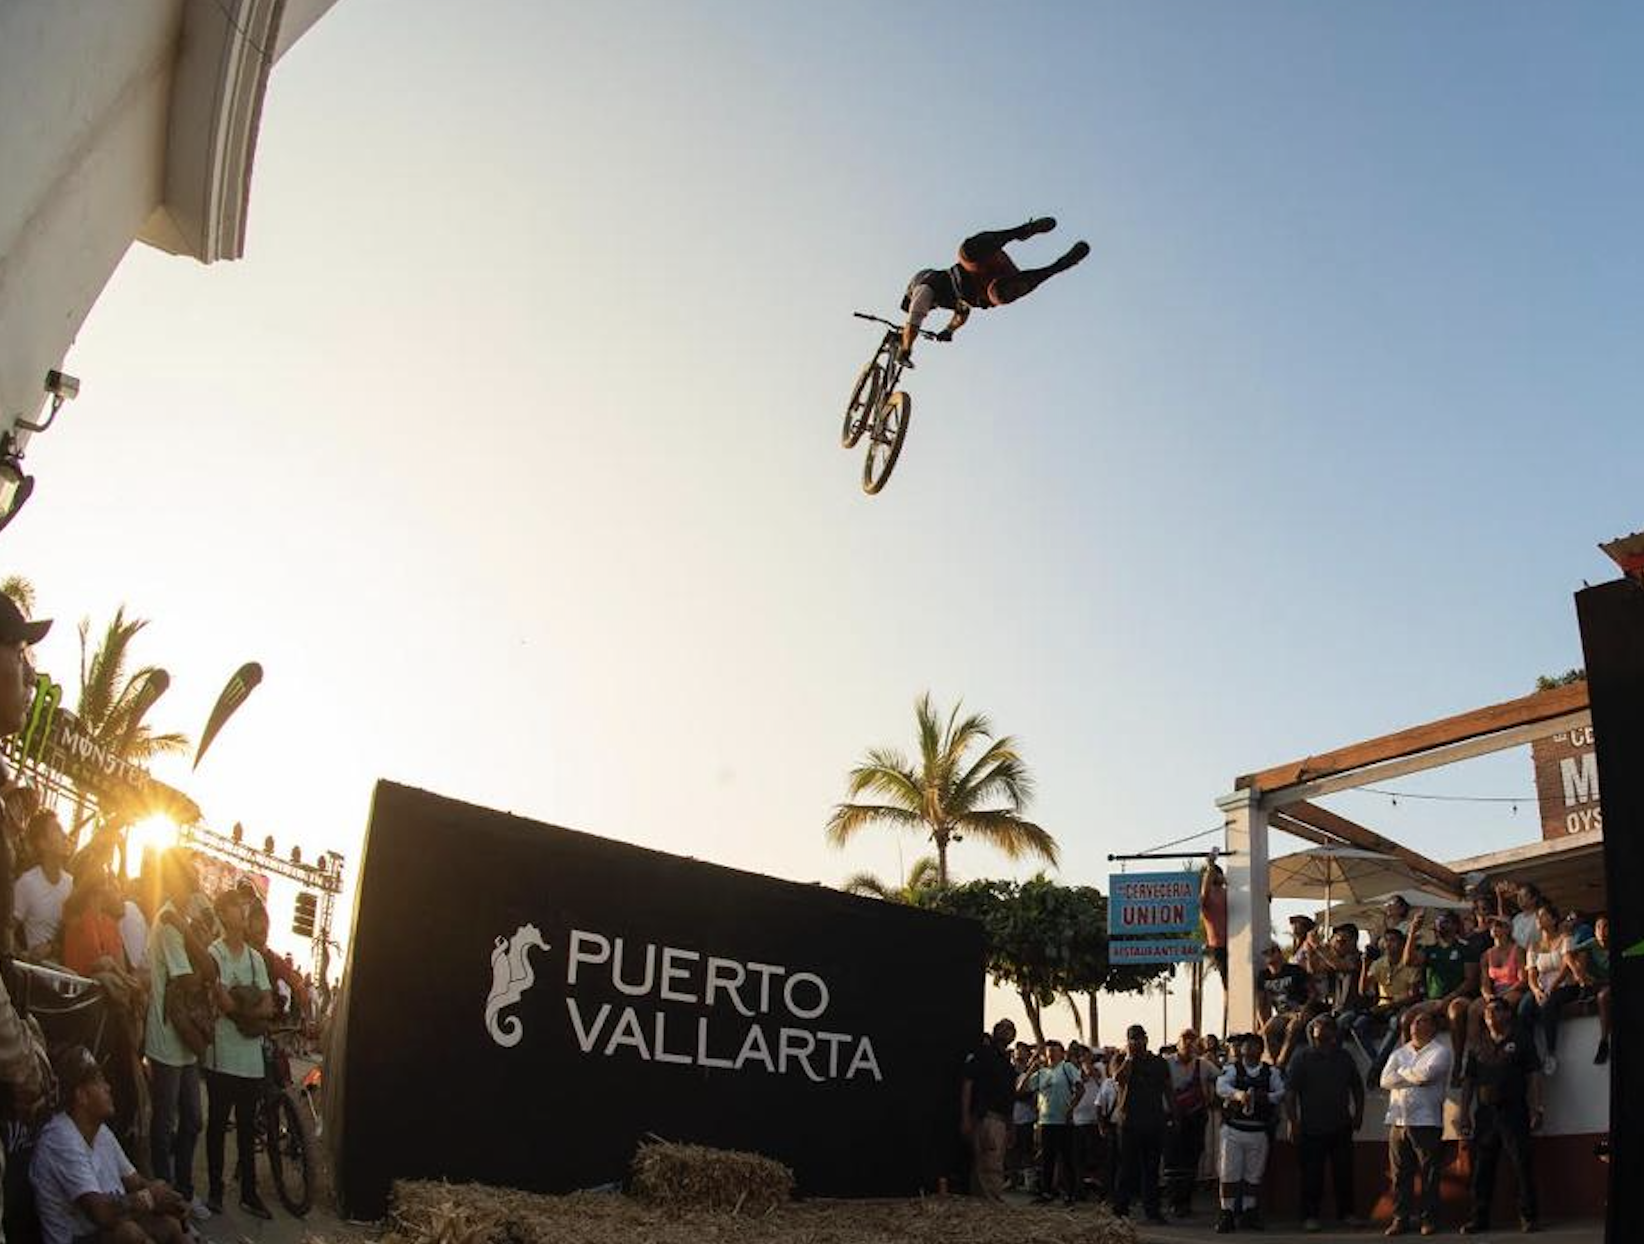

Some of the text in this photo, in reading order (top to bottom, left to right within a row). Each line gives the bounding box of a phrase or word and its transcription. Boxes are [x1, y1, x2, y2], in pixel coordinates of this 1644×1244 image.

[1560, 752, 1600, 807] M
[1122, 905, 1185, 925] UNION
[1126, 881, 1192, 900] CERVECERIA
[567, 929, 830, 1019] PUERTO
[566, 997, 882, 1082] VALLARTA
